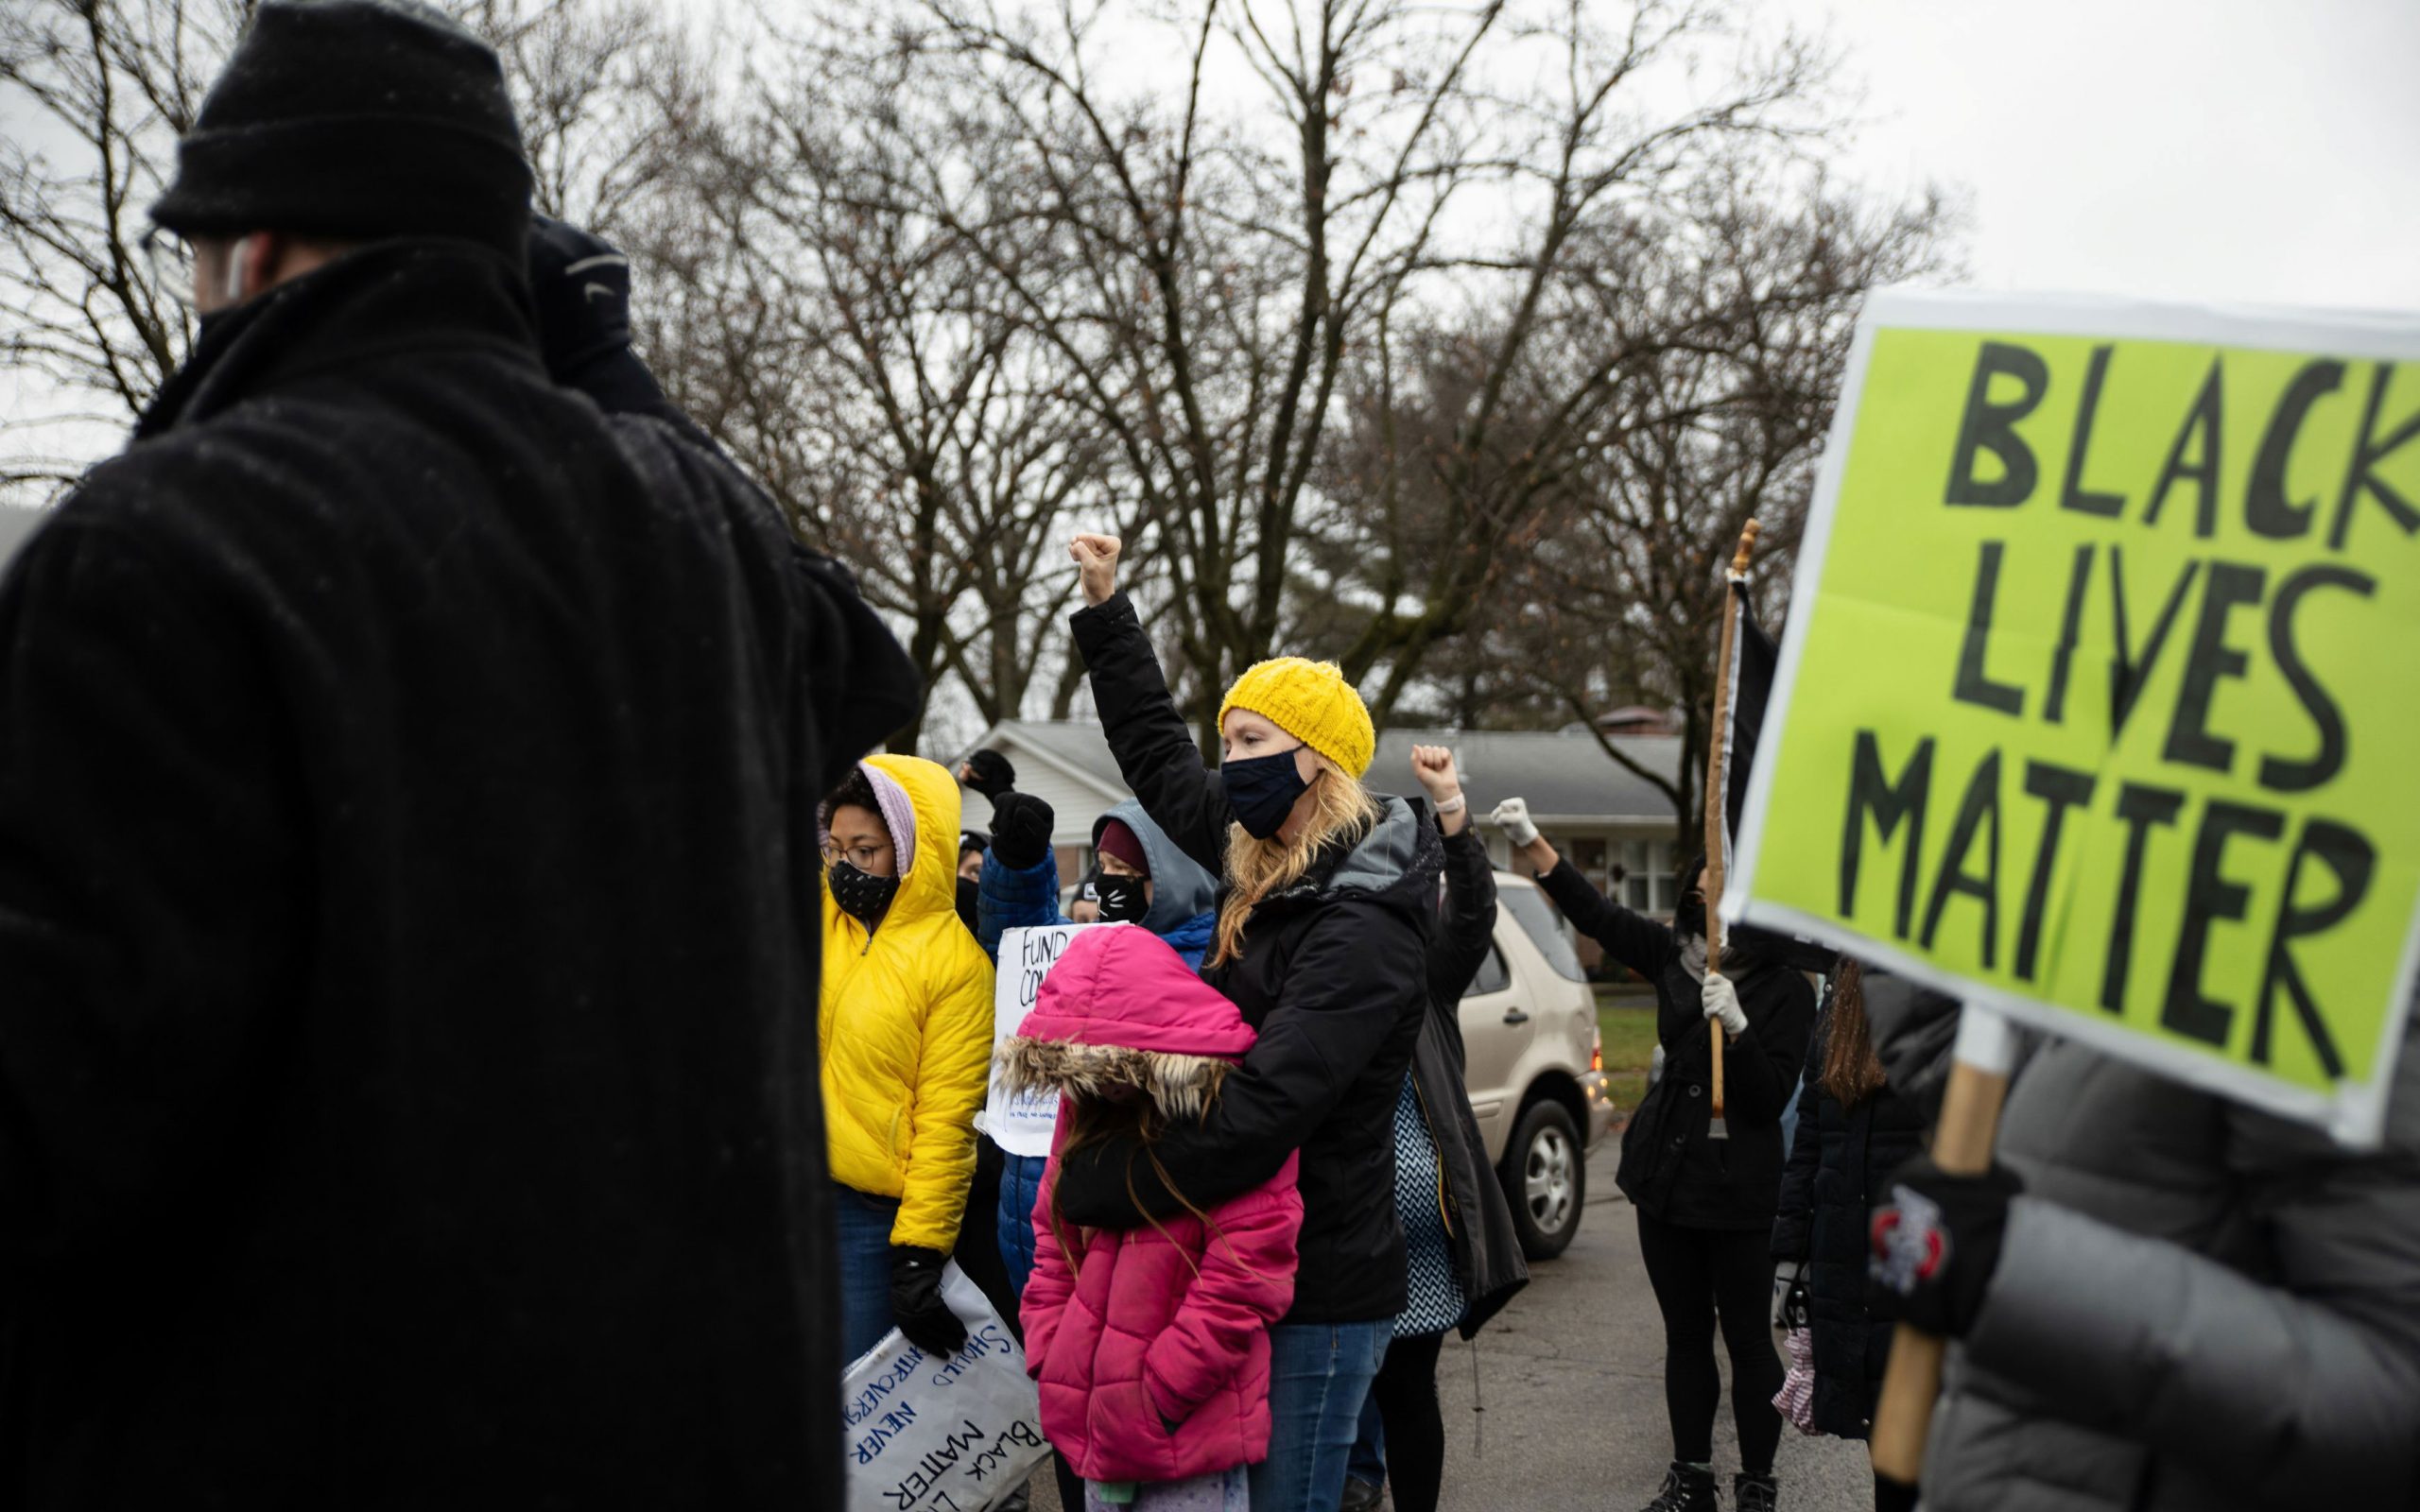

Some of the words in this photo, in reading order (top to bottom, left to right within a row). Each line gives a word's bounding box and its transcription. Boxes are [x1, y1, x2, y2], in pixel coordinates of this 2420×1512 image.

[1943, 340, 2420, 552] BLACK
[1950, 538, 2379, 796] LIVES
[1022, 926, 1068, 968] FUND
[1836, 726, 2379, 1082] MATTER
[933, 1324, 1011, 1387] SHOULD
[850, 1400, 917, 1465] NEVER
[883, 1419, 985, 1511] MATTER
